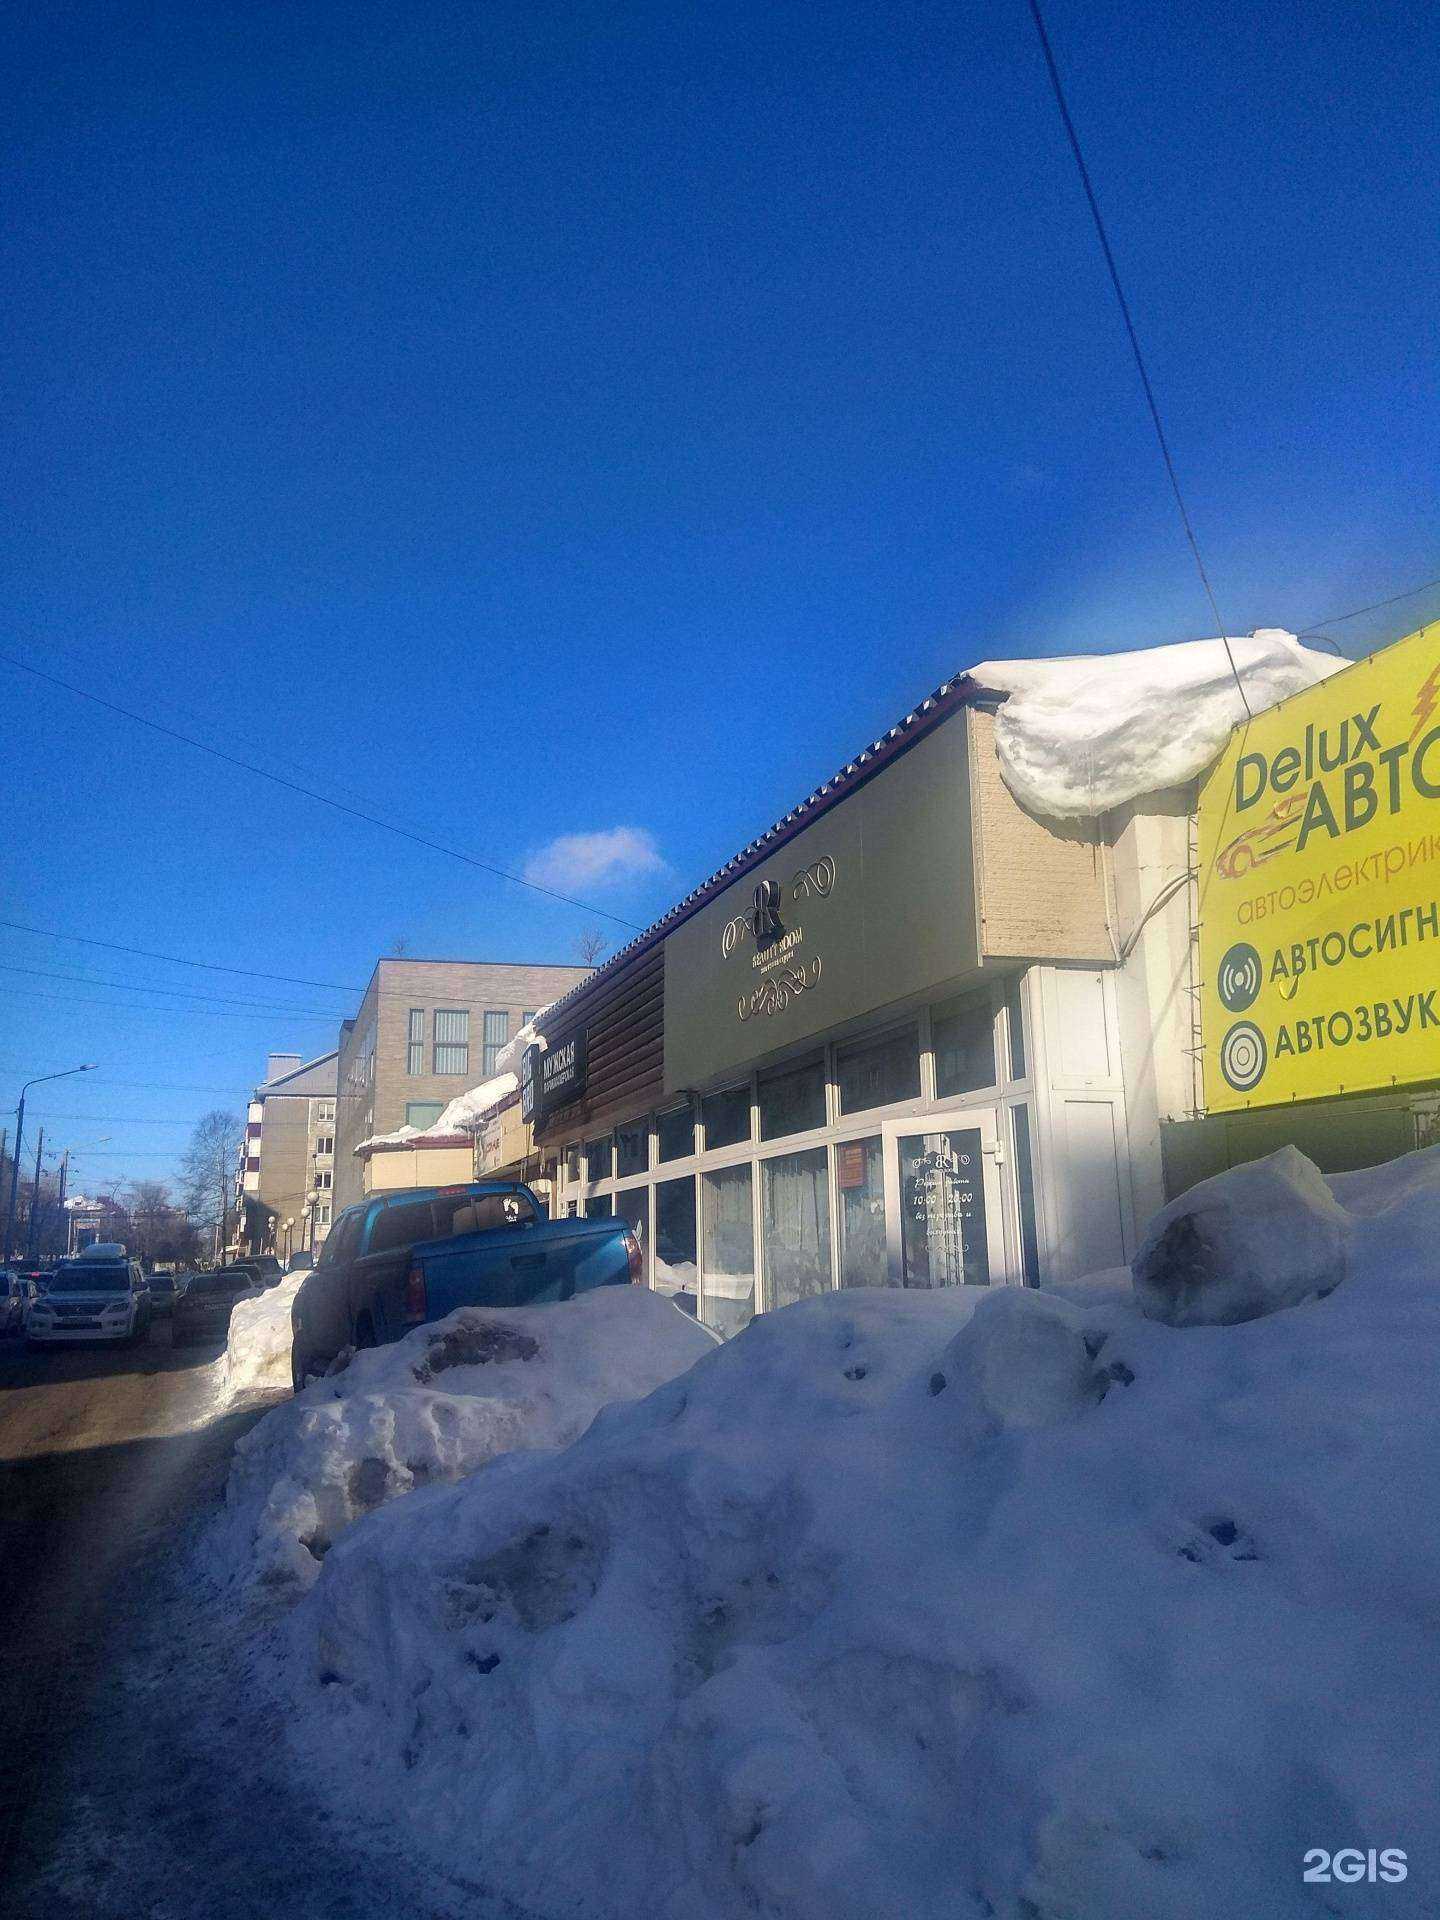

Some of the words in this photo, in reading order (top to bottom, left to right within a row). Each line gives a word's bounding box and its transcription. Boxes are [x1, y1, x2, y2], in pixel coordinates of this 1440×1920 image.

[1235, 703, 1381, 813] Delux
[1269, 901, 1439, 983] АВТОСИГН
[543, 1040, 575, 1080] МУЖСКАЯ
[1274, 990, 1440, 1059] АВТОЗВУК
